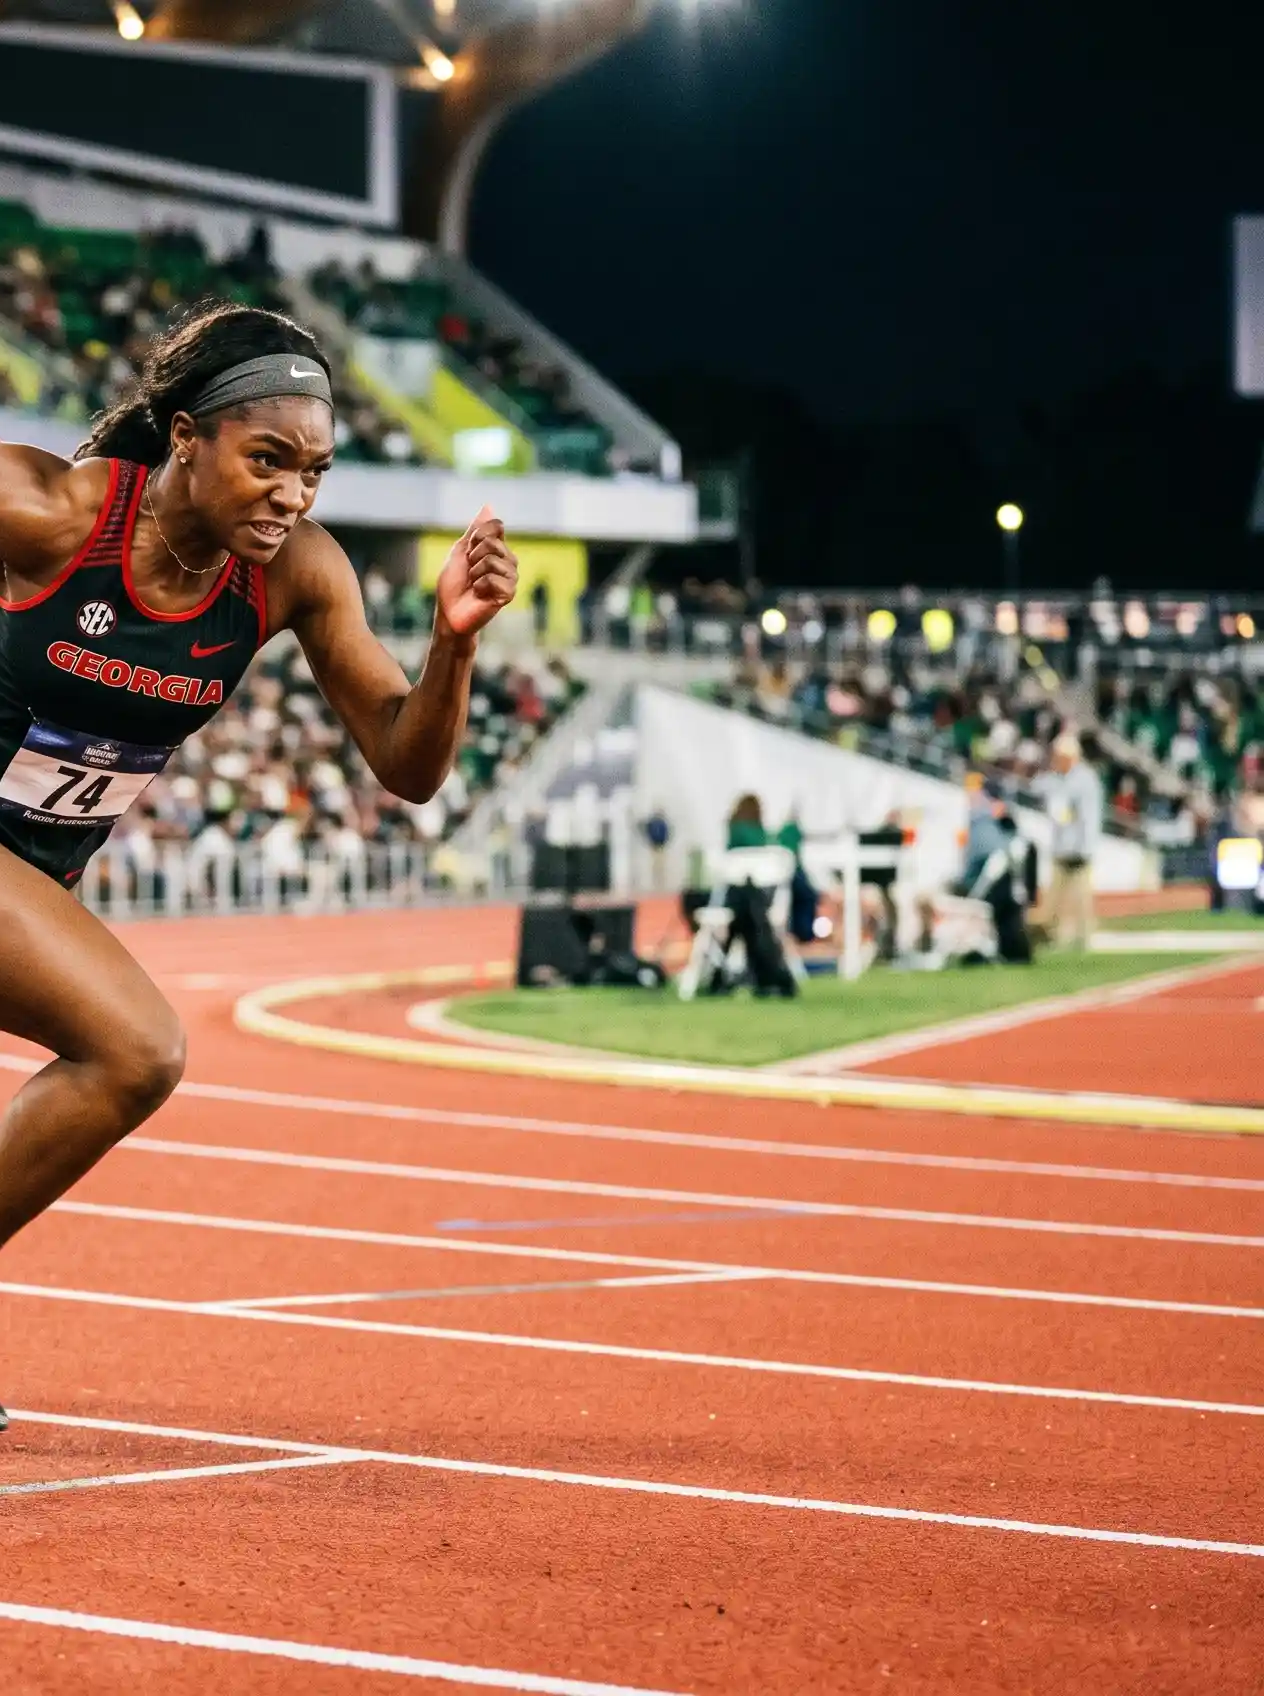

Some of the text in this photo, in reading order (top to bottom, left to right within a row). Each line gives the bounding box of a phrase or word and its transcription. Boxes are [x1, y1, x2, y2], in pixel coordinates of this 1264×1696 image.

[78, 601, 115, 636] SEC
[46, 640, 224, 706] GEORGIA
[39, 765, 115, 814] 74
